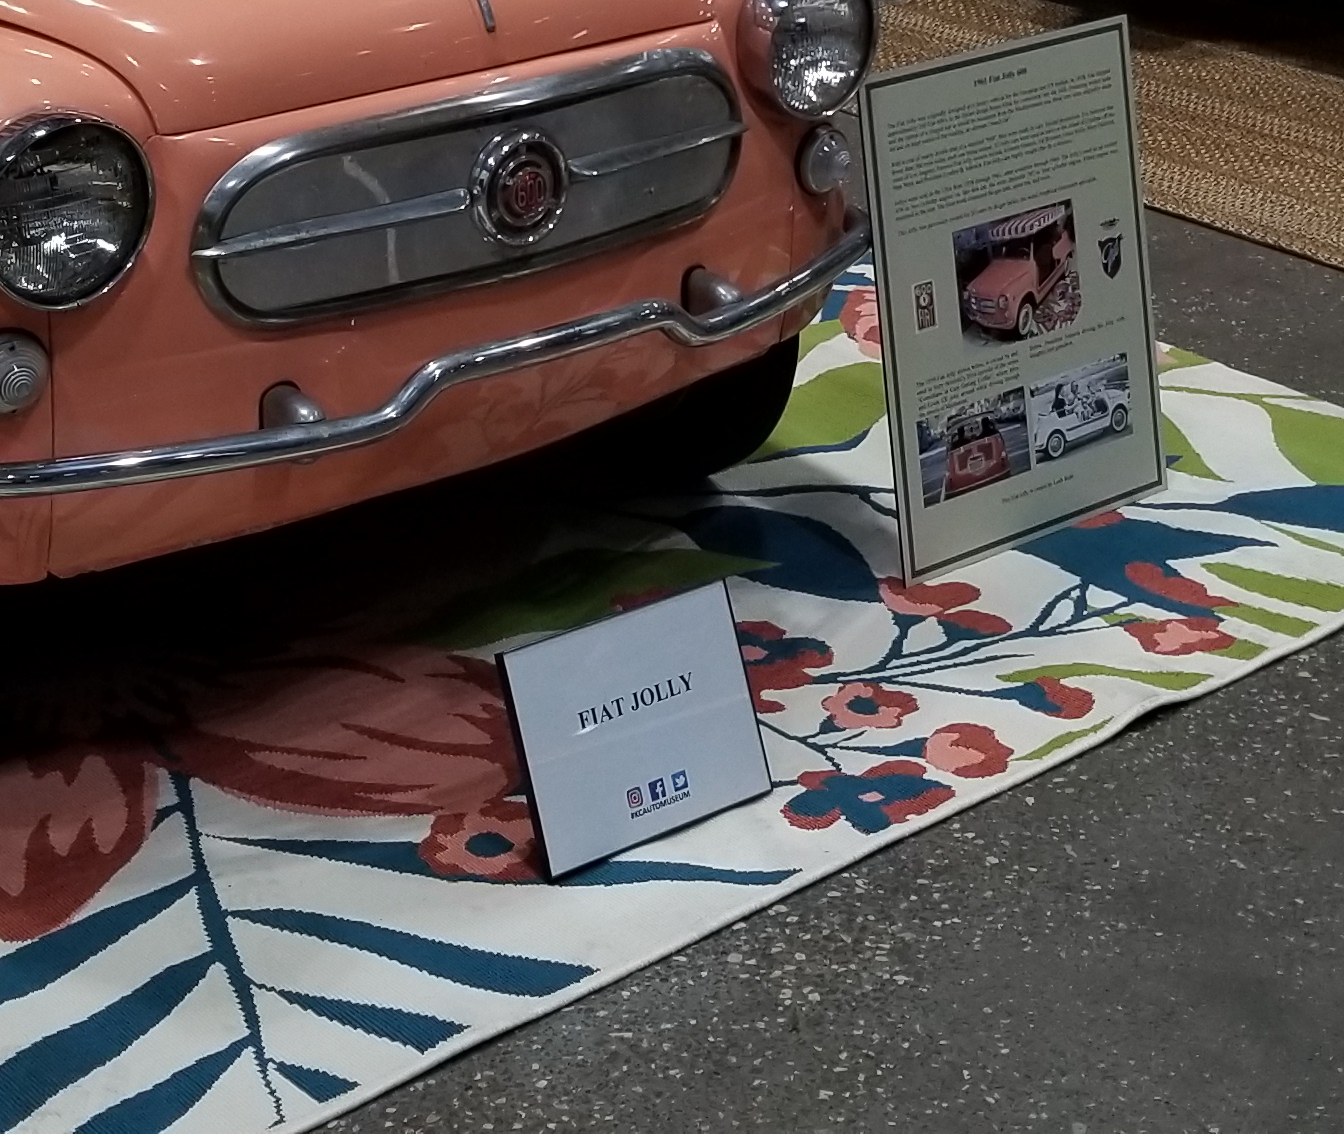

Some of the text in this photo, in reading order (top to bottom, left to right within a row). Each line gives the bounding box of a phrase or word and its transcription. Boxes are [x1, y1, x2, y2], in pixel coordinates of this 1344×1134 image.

[517, 176, 544, 207] 600
[577, 671, 692, 730] FIAT JOLLY
[630, 789, 692, 820] #KCAUTOMUSEUM
